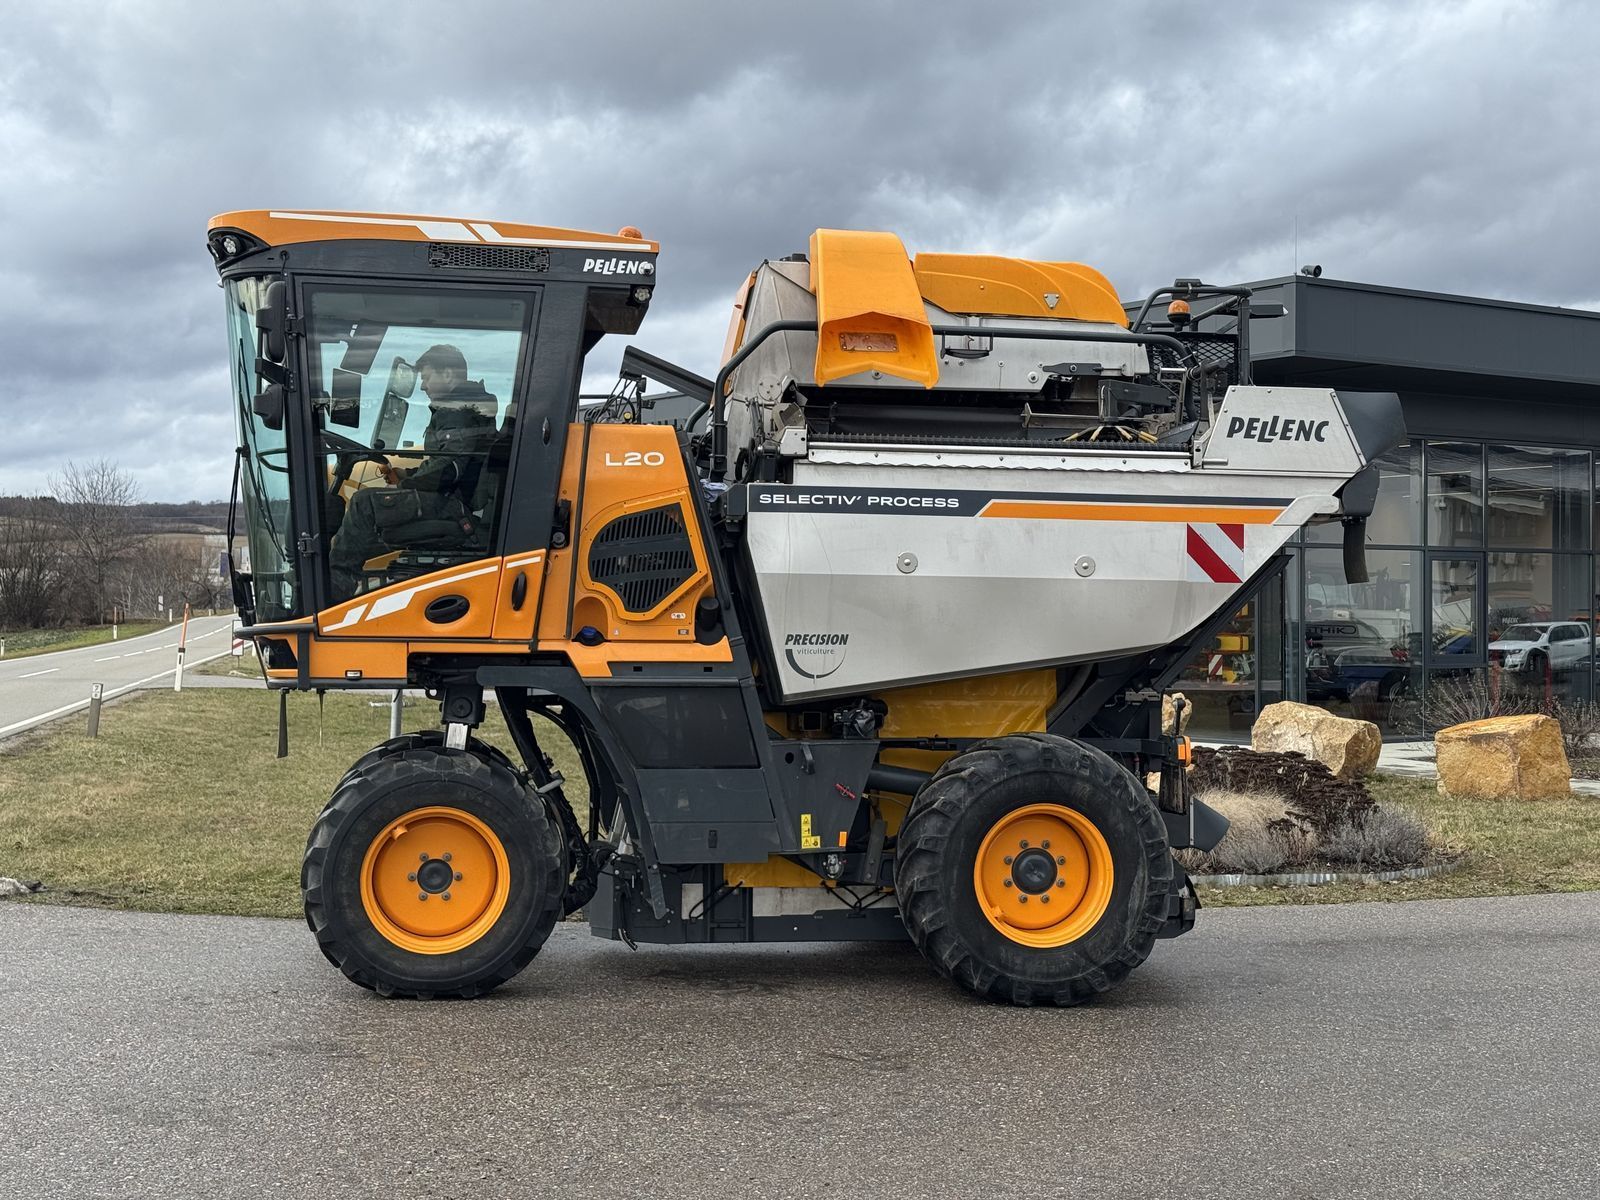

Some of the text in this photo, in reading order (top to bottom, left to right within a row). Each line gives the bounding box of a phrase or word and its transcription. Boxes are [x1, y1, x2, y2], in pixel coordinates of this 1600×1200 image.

[1226, 415, 1330, 443] PELLENC
[605, 451, 665, 466] L20
[867, 496, 960, 508] PROCESS
[785, 633, 849, 646] PRECISION
